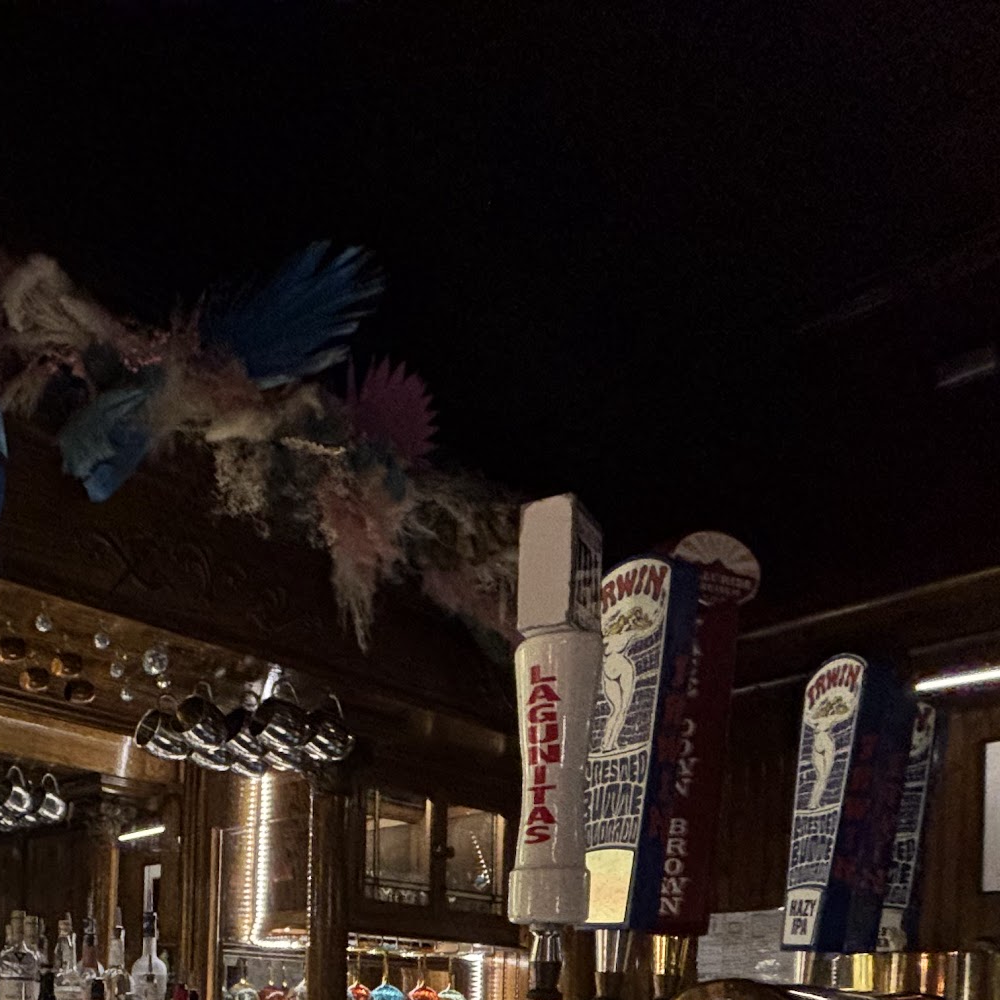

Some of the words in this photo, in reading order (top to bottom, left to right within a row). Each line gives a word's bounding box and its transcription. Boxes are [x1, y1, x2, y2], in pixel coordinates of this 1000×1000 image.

[601, 565, 668, 614] RWIN
[807, 664, 860, 710] IRWIN
[524, 665, 561, 844] LAGUNITAS
[658, 817, 691, 916] BROWN
[789, 899, 816, 917] HAZY
[791, 917, 807, 936] IPA
